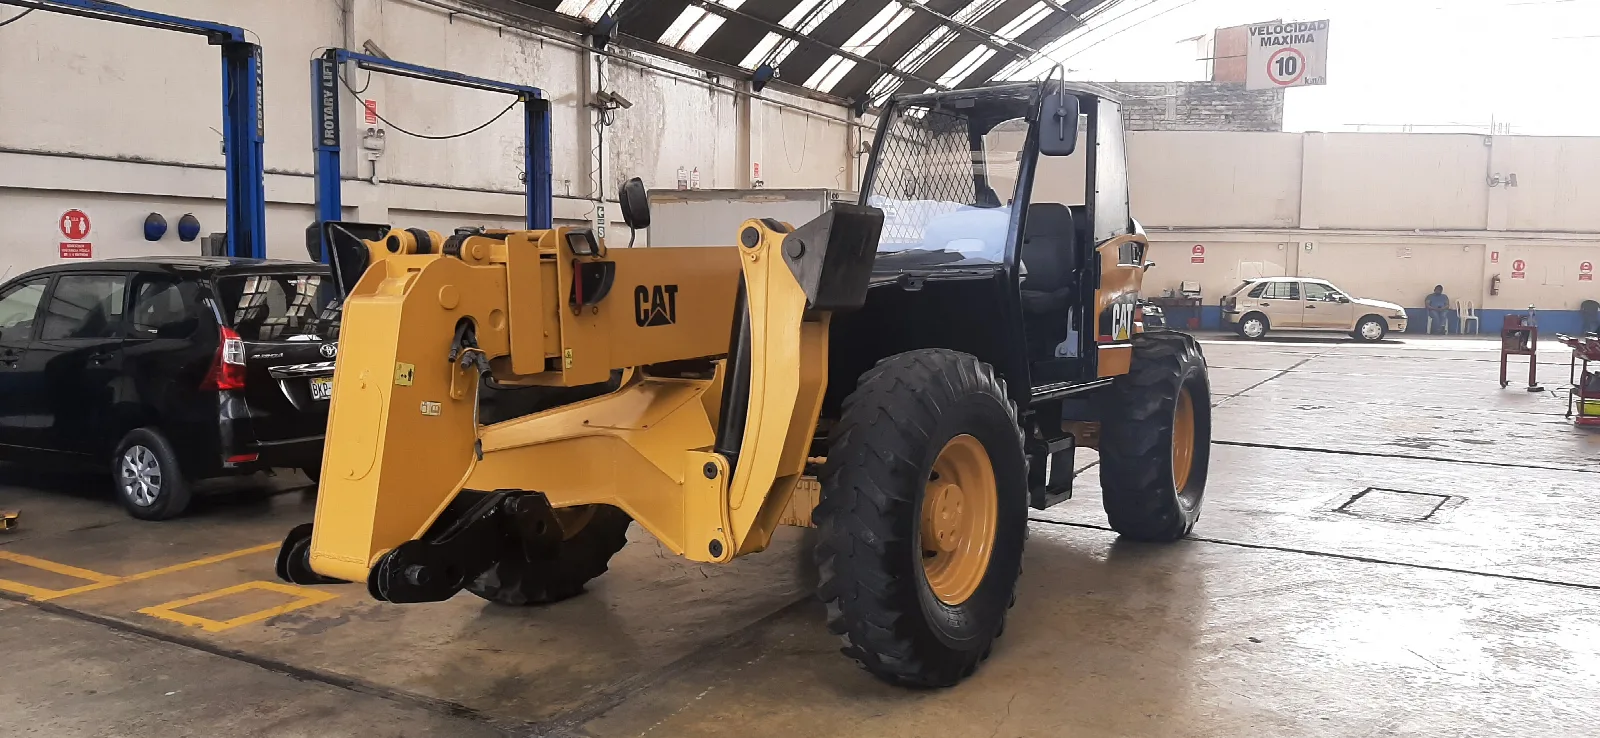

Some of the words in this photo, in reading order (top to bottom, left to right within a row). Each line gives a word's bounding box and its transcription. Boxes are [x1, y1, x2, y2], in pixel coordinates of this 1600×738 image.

[1249, 22, 1327, 36] VELOCIDAD
[1261, 33, 1314, 47] MAXIMA
[323, 61, 333, 86] LIFT
[1276, 56, 1297, 76] 10
[324, 90, 334, 138] ROTARY
[599, 227, 604, 238] S
[634, 284, 678, 327] CAT
[1112, 303, 1133, 340] CAT
